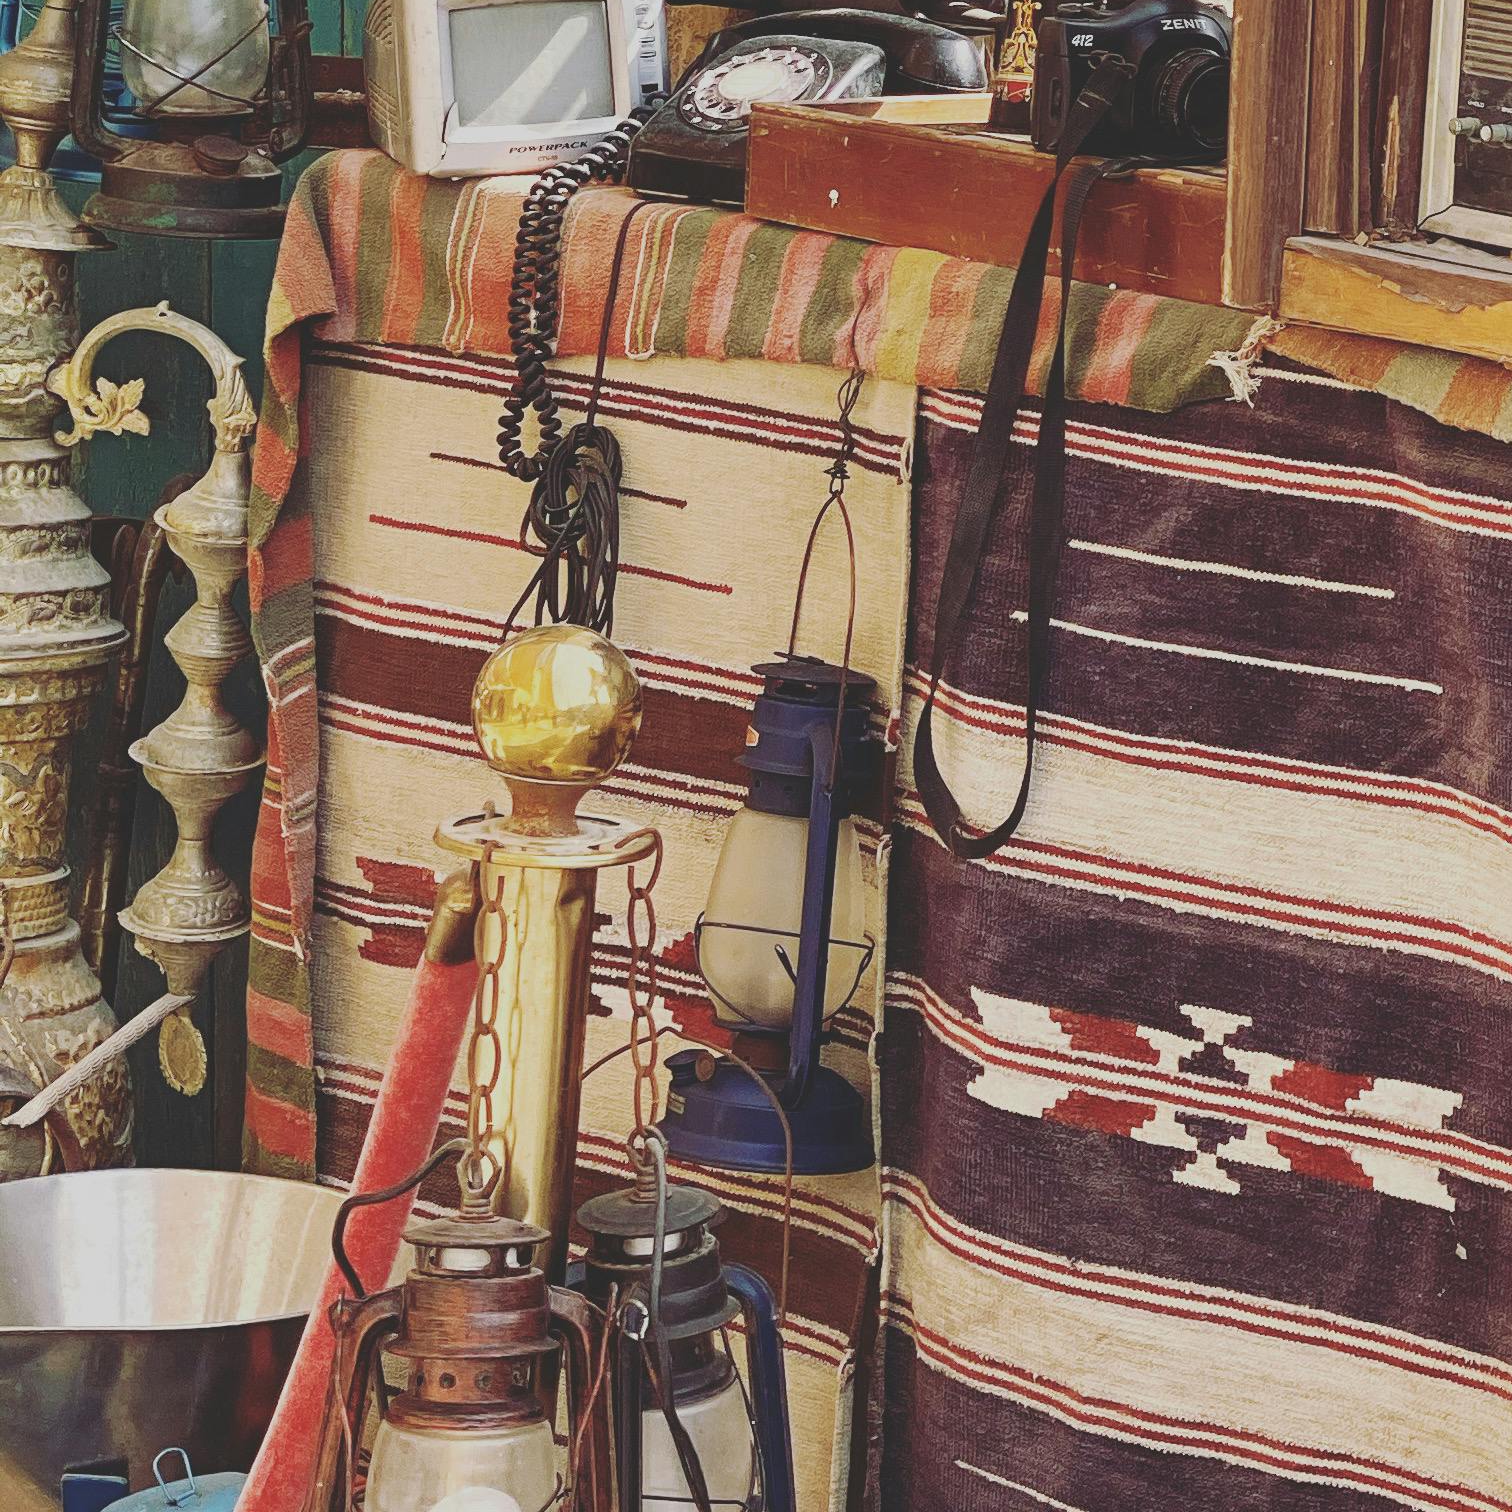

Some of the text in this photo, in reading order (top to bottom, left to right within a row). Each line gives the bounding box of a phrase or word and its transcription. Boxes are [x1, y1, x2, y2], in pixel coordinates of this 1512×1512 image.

[1160, 18, 1207, 31] ZENIT
[1071, 34, 1094, 47] 412
[509, 141, 588, 154] POWERPACK
